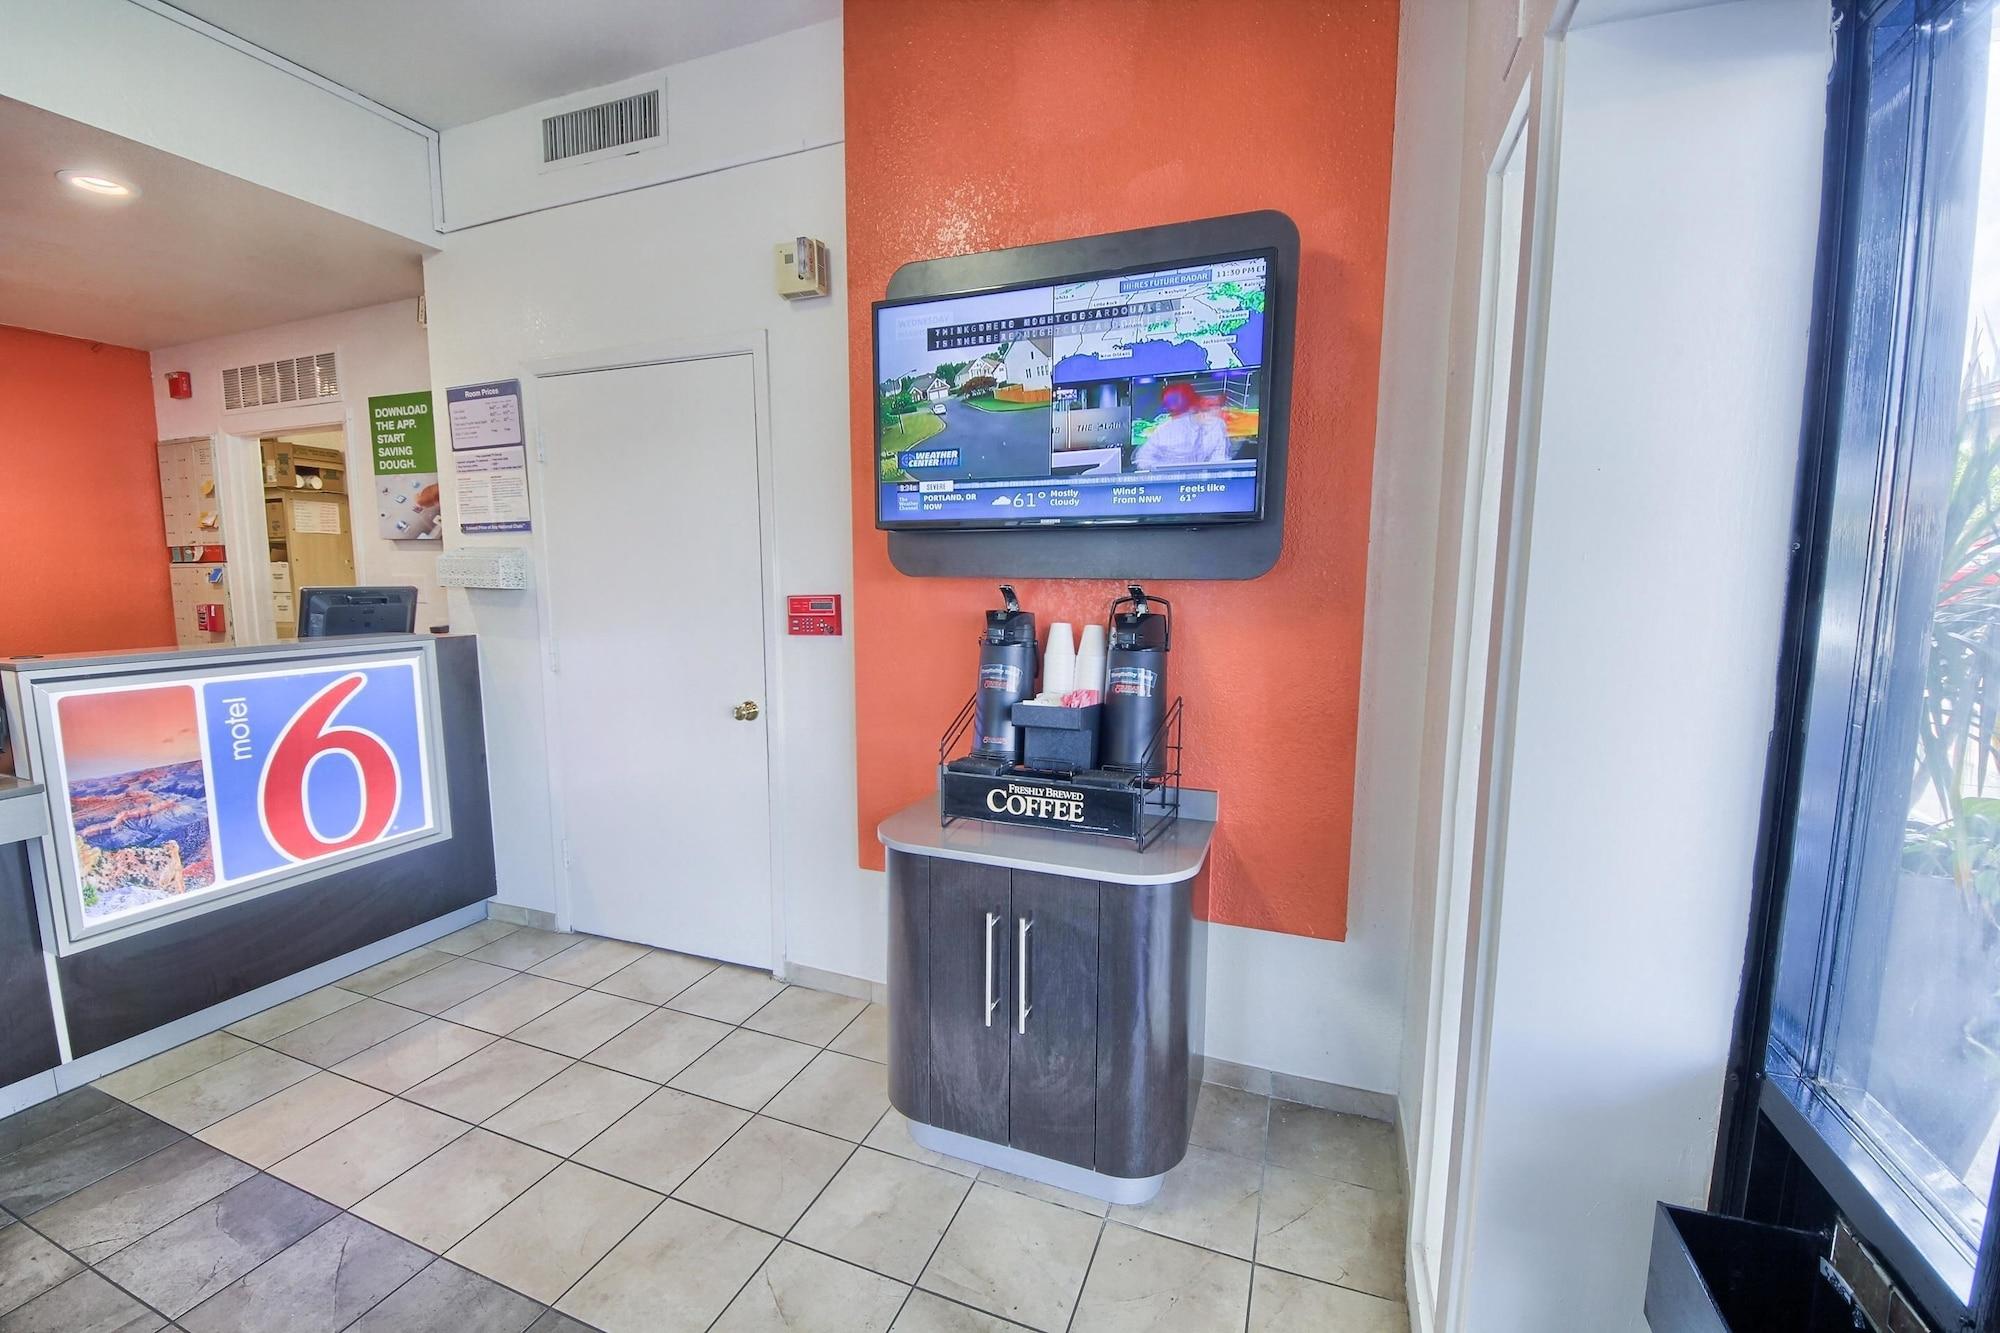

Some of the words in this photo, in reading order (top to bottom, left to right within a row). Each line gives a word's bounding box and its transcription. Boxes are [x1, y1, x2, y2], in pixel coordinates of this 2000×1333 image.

[1217, 269, 1240, 278] 11:30
[1242, 267, 1255, 275] PM
[1150, 277, 1180, 288] FUTURE
[1181, 273, 1208, 283] RADAR
[464, 390, 481, 398] Room
[481, 388, 499, 396] Prices
[374, 404, 428, 418] DOWNLOAD
[375, 420, 395, 431] THE
[397, 419, 417, 430] APP.
[377, 433, 406, 444] START
[378, 446, 413, 457] SAVING
[915, 450, 958, 459] WEATHER
[379, 459, 417, 470] DOUGH.
[926, 483, 946, 491] SEVERE
[1112, 487, 1137, 496] Wind
[1138, 487, 1145, 495] 5
[1180, 484, 1205, 493] Feels
[1206, 483, 1226, 492] like
[923, 494, 964, 502] PORTLAND,
[965, 493, 977, 501] OR
[1050, 489, 1079, 498] Mostly
[1179, 493, 1197, 502] 61°
[1013, 491, 1046, 508] 61°
[1112, 496, 1137, 504] From
[1138, 495, 1162, 503] NNW
[222, 697, 253, 761] motel
[257, 672, 402, 861] 6
[1008, 783, 1045, 797] FRESHLY
[1045, 787, 1084, 801] BREWED
[986, 788, 1085, 823] COFFEE
